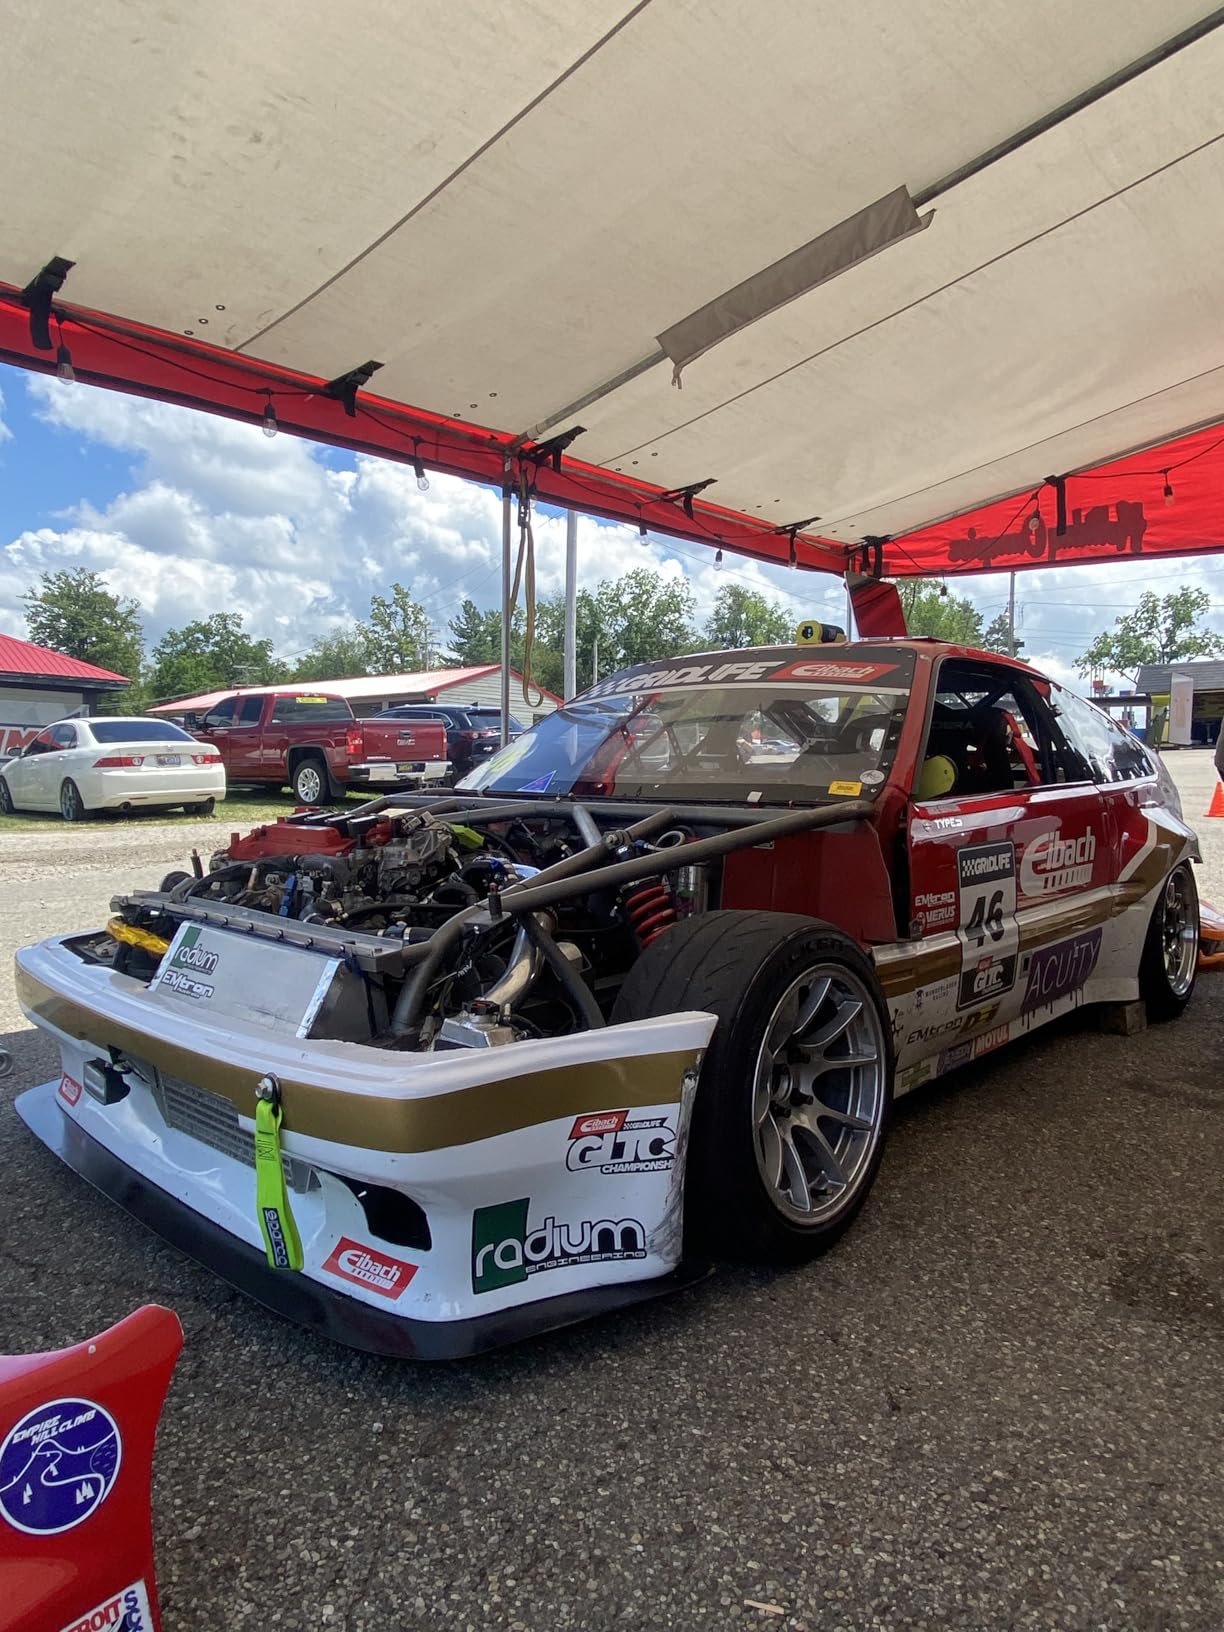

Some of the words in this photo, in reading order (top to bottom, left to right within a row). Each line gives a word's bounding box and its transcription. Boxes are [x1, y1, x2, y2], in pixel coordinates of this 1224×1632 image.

[614, 661, 787, 693] GRIDLIFE
[791, 664, 879, 679] Eibach
[973, 852, 1012, 876] GRIDLIFE
[1019, 826, 1097, 897] Eibach
[925, 905, 957, 923] VERUS
[964, 889, 1005, 948] 46
[975, 1023, 1010, 1052] MOTUL
[580, 1115, 619, 1133] Eibach
[567, 1128, 676, 1171] GLTC
[264, 1209, 288, 1267] sparco
[475, 1216, 646, 1278] radium
[338, 1249, 402, 1290] Eibach
[12, 1415, 62, 1444] EMPIRE
